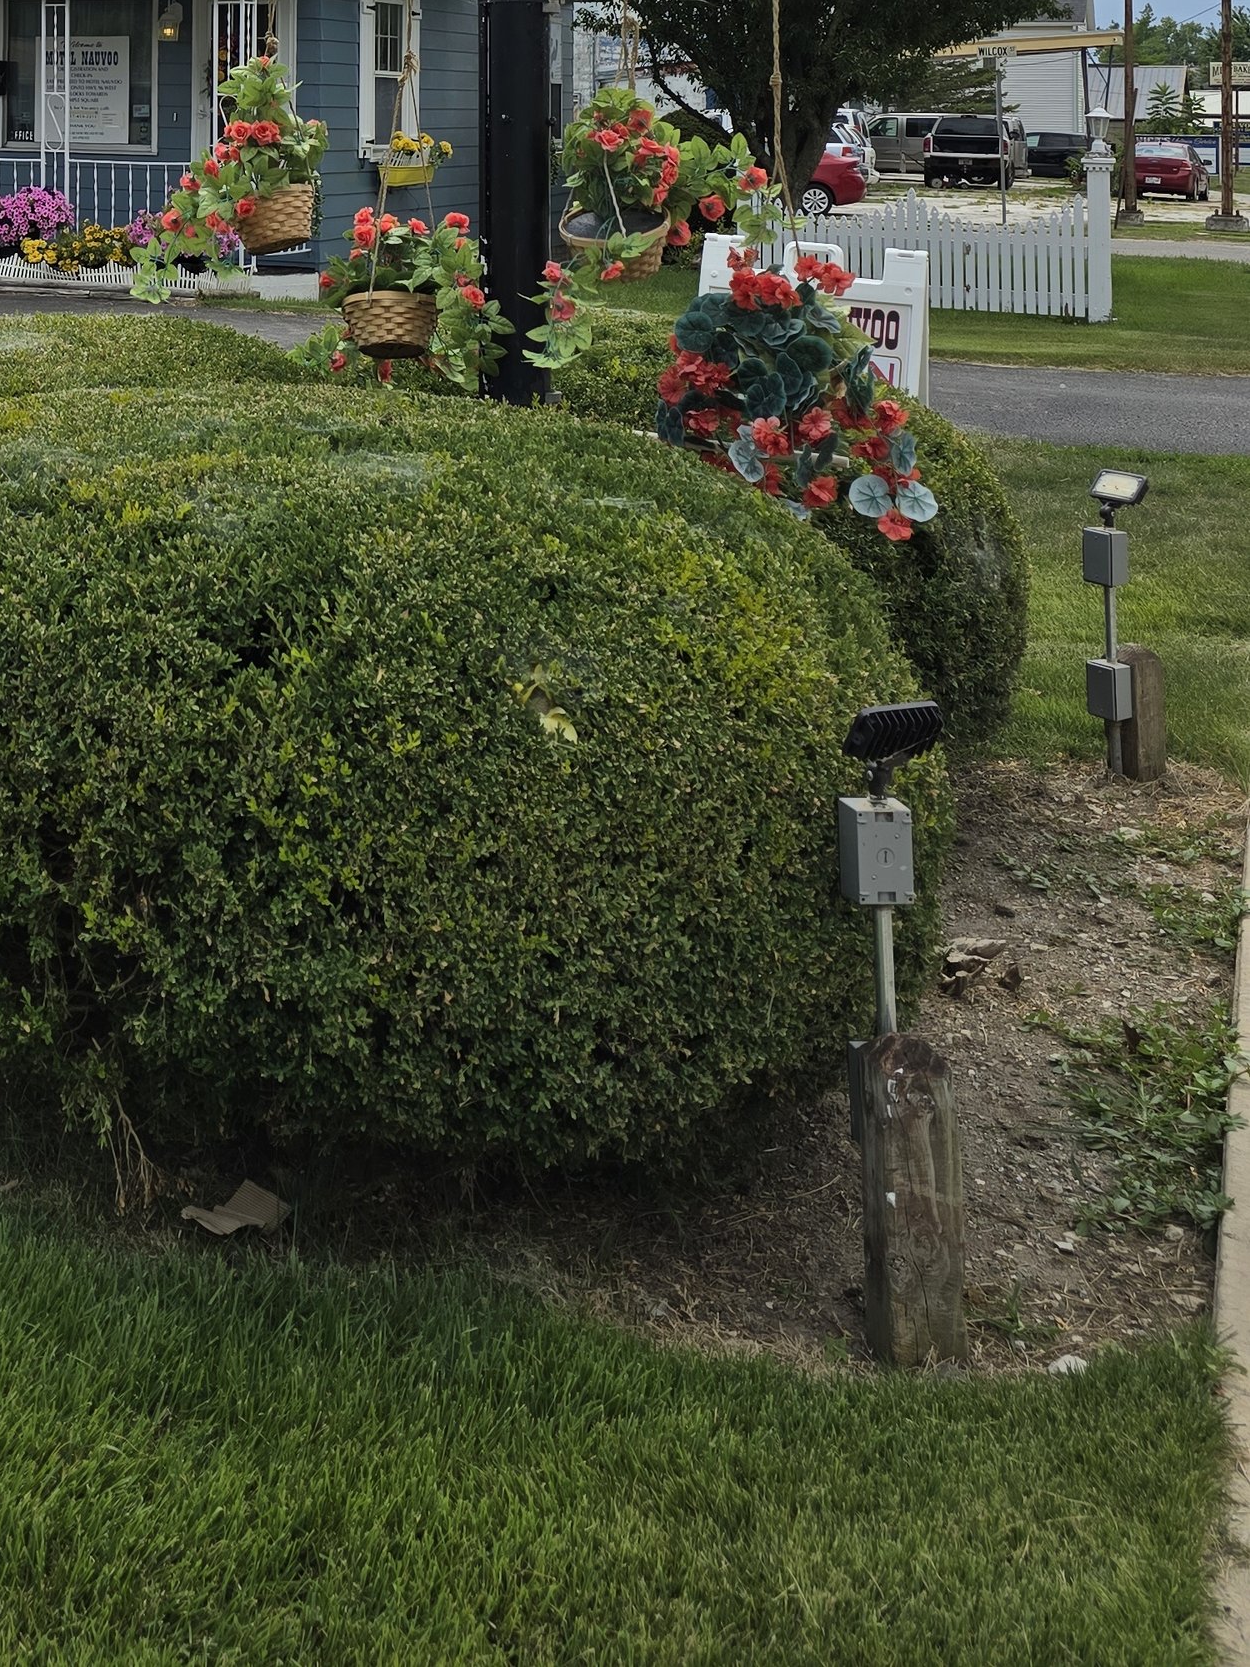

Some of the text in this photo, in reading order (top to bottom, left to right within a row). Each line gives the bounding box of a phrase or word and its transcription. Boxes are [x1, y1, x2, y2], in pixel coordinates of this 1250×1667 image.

[978, 46, 1008, 56] WILCOX
[81, 50, 119, 66] NAUVOO
[11, 130, 33, 141] FFICE
